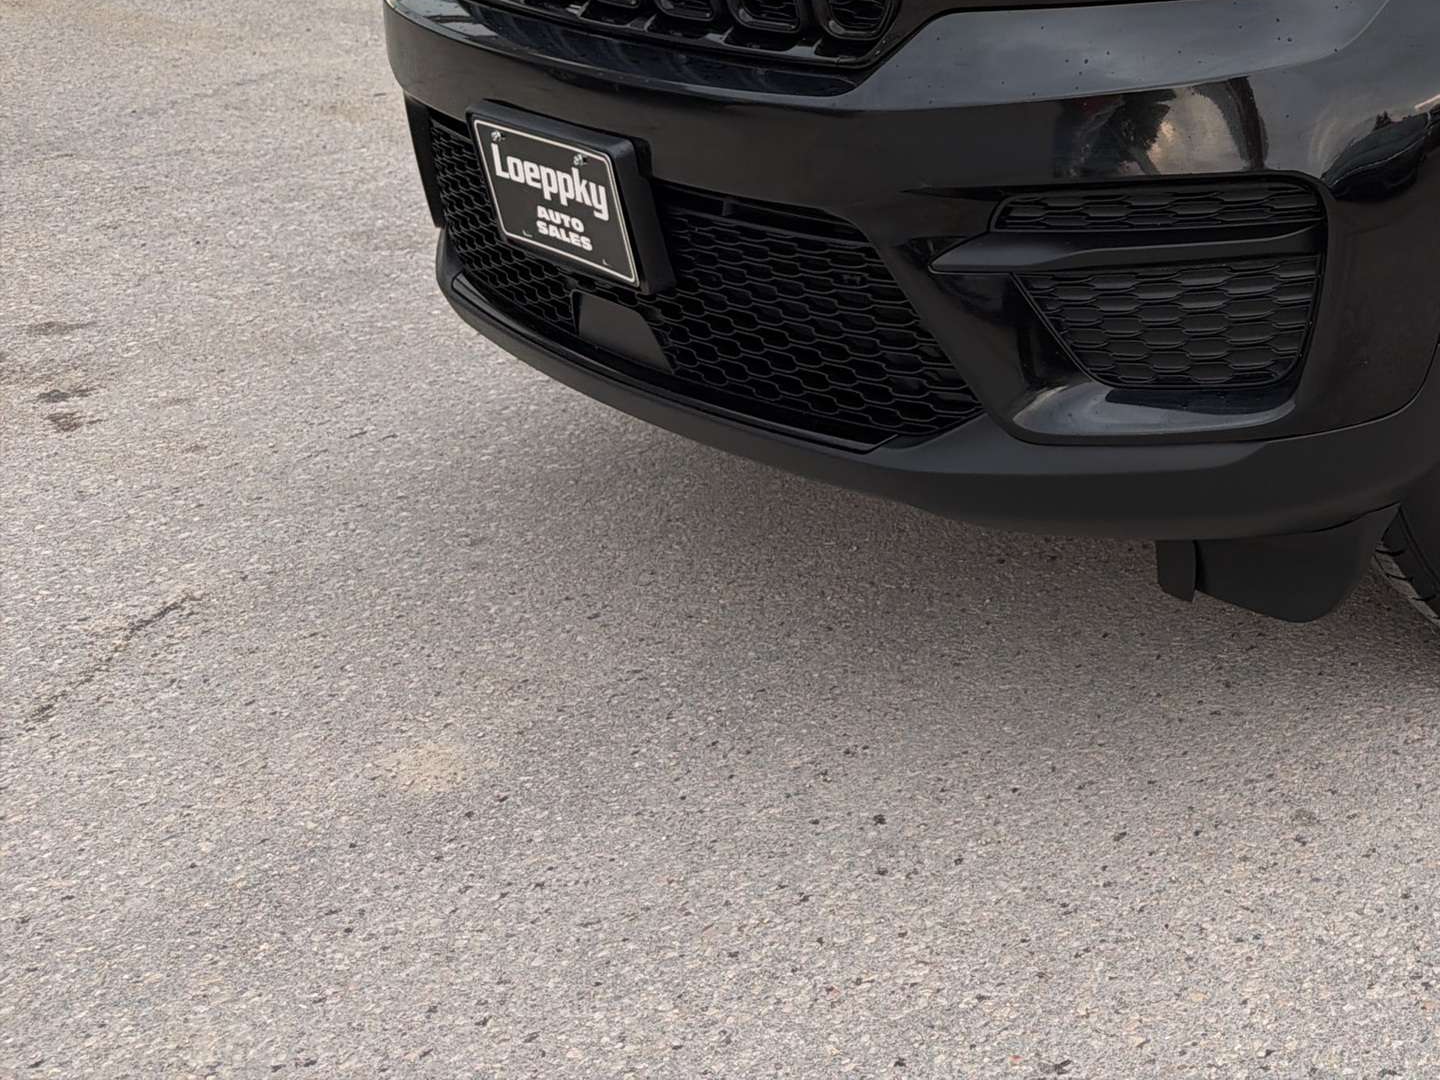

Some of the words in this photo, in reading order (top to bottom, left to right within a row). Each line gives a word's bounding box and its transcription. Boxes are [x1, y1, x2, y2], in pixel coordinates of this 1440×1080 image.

[490, 142, 609, 222] Loeppky
[536, 205, 585, 233] AUTO
[536, 220, 593, 252] SALES
